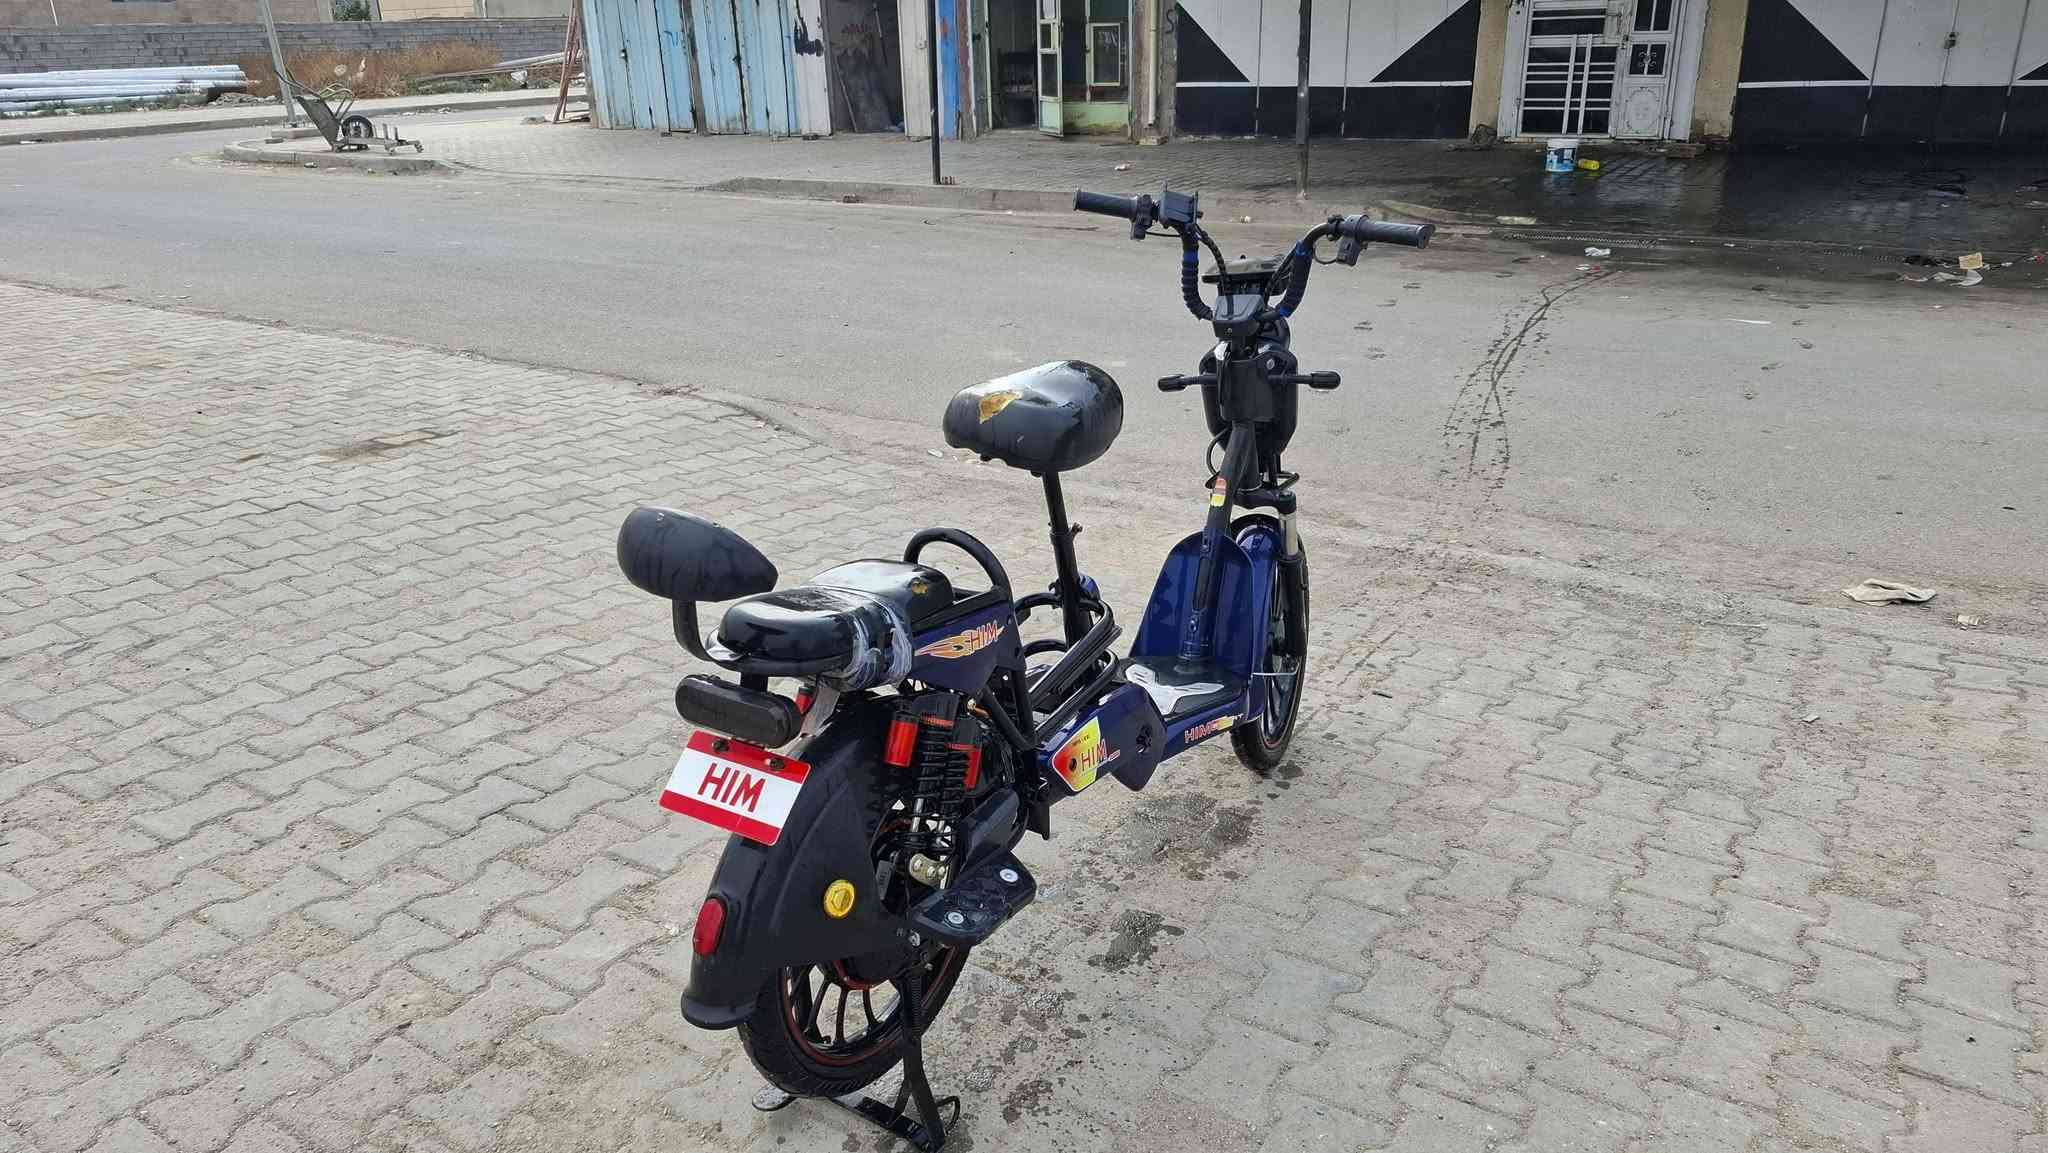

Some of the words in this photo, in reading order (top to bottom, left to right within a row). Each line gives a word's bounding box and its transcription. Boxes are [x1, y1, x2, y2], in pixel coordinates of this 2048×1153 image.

[970, 619, 998, 651] HIM
[1081, 738, 1107, 772] HIM
[697, 762, 766, 812] HIM
